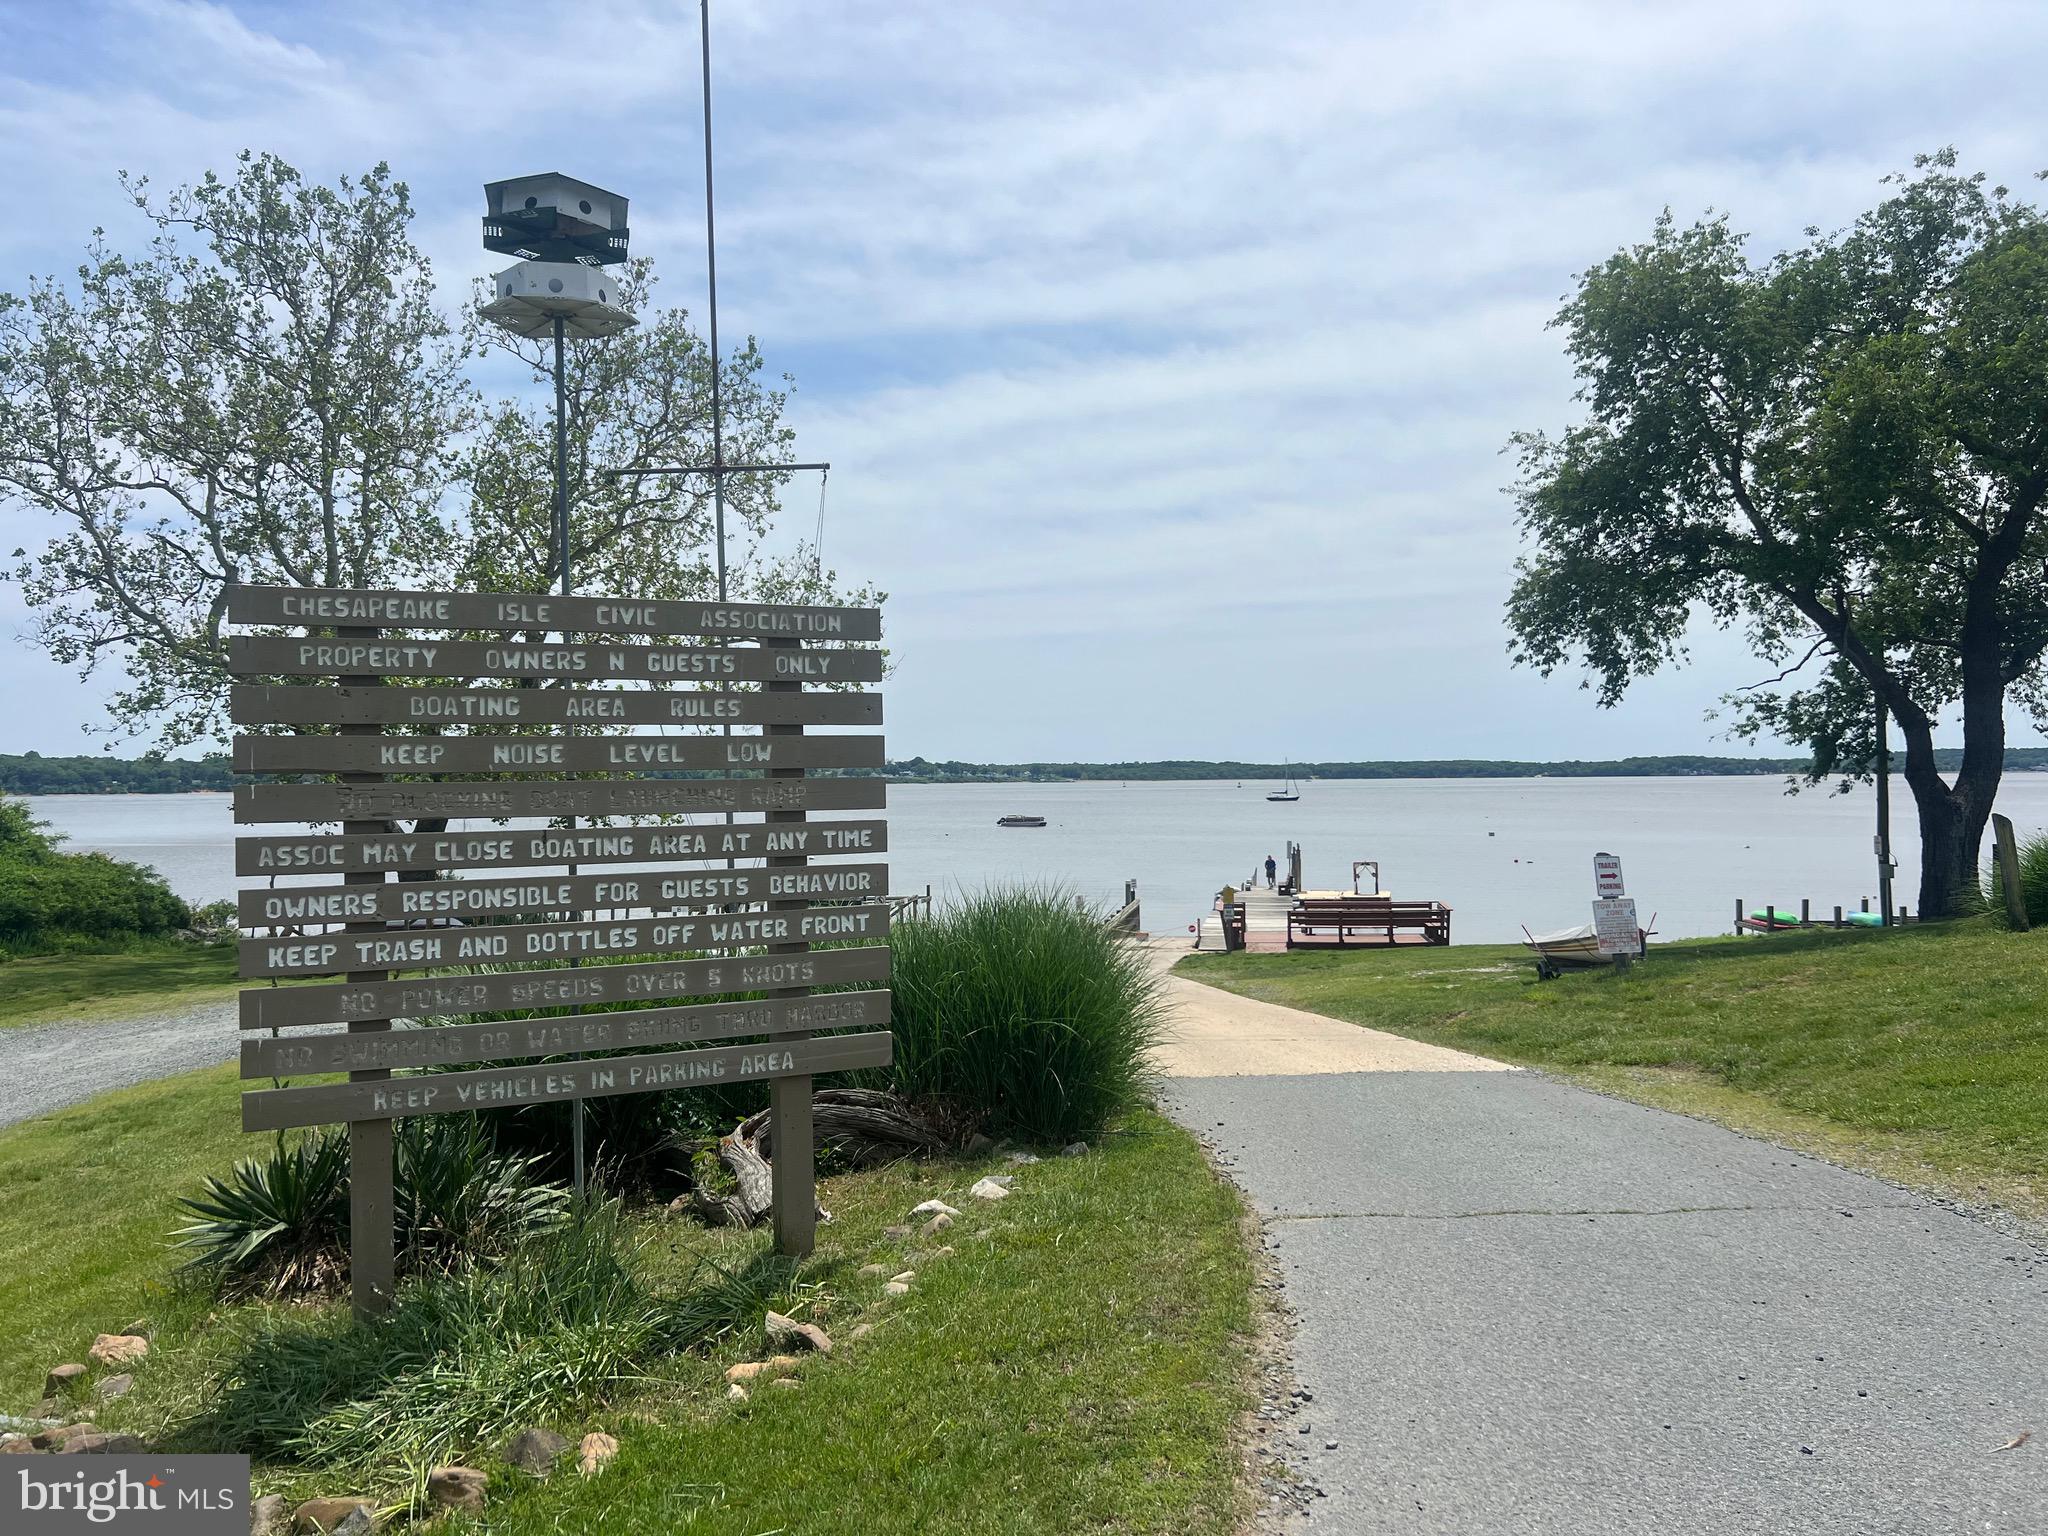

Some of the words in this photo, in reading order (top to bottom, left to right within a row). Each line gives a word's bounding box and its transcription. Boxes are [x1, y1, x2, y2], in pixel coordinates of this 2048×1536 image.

[282, 596, 450, 620] CHESAPEAKE
[498, 603, 551, 622] ISLE
[596, 605, 657, 626] CIVIC
[700, 609, 842, 632] ASSOCIATION
[300, 645, 437, 668] PROPERTY
[485, 649, 587, 670] OWNERS
[609, 652, 625, 671] N
[647, 653, 735, 672] GUESTS
[775, 655, 831, 674] ONLY
[411, 696, 520, 716] BOATING
[566, 697, 626, 717] AREA
[670, 697, 741, 717] RULES
[381, 744, 445, 764] KEEP
[493, 743, 565, 764] NOISE
[610, 743, 685, 763] LEVEL
[727, 743, 773, 762] LOW
[258, 844, 344, 867] ASSOC
[362, 841, 416, 864] MAY
[434, 840, 514, 861] CLOSE
[530, 835, 634, 859] BOATING
[649, 834, 706, 855] AREA
[721, 833, 751, 852] AT
[766, 831, 808, 850] ANY
[822, 829, 873, 848] TIME
[265, 893, 377, 919] OWNERS
[403, 884, 571, 913] RESPONSIBLE
[595, 882, 639, 902] FOR
[661, 877, 749, 899] GUESTS
[769, 872, 871, 895] BEHAVIOR
[268, 944, 337, 968] KEEP
[355, 939, 441, 963] TRASH
[459, 935, 508, 958] AND
[526, 927, 638, 953] BOTTLES
[653, 924, 695, 945] OFF
[710, 918, 788, 941] WATER
[801, 913, 870, 935] FRONT
[340, 992, 376, 1014] NO
[402, 985, 487, 1010] POWER
[512, 977, 603, 1002] SPEEDS
[626, 972, 686, 993] OVER
[708, 968, 722, 988] 5
[742, 961, 814, 983] KNOTS
[374, 1086, 438, 1111] KEEP
[457, 1074, 577, 1102] VEHICLES
[591, 1070, 615, 1090] IN
[630, 1058, 726, 1086] PARKING
[740, 1052, 794, 1075] AREA
